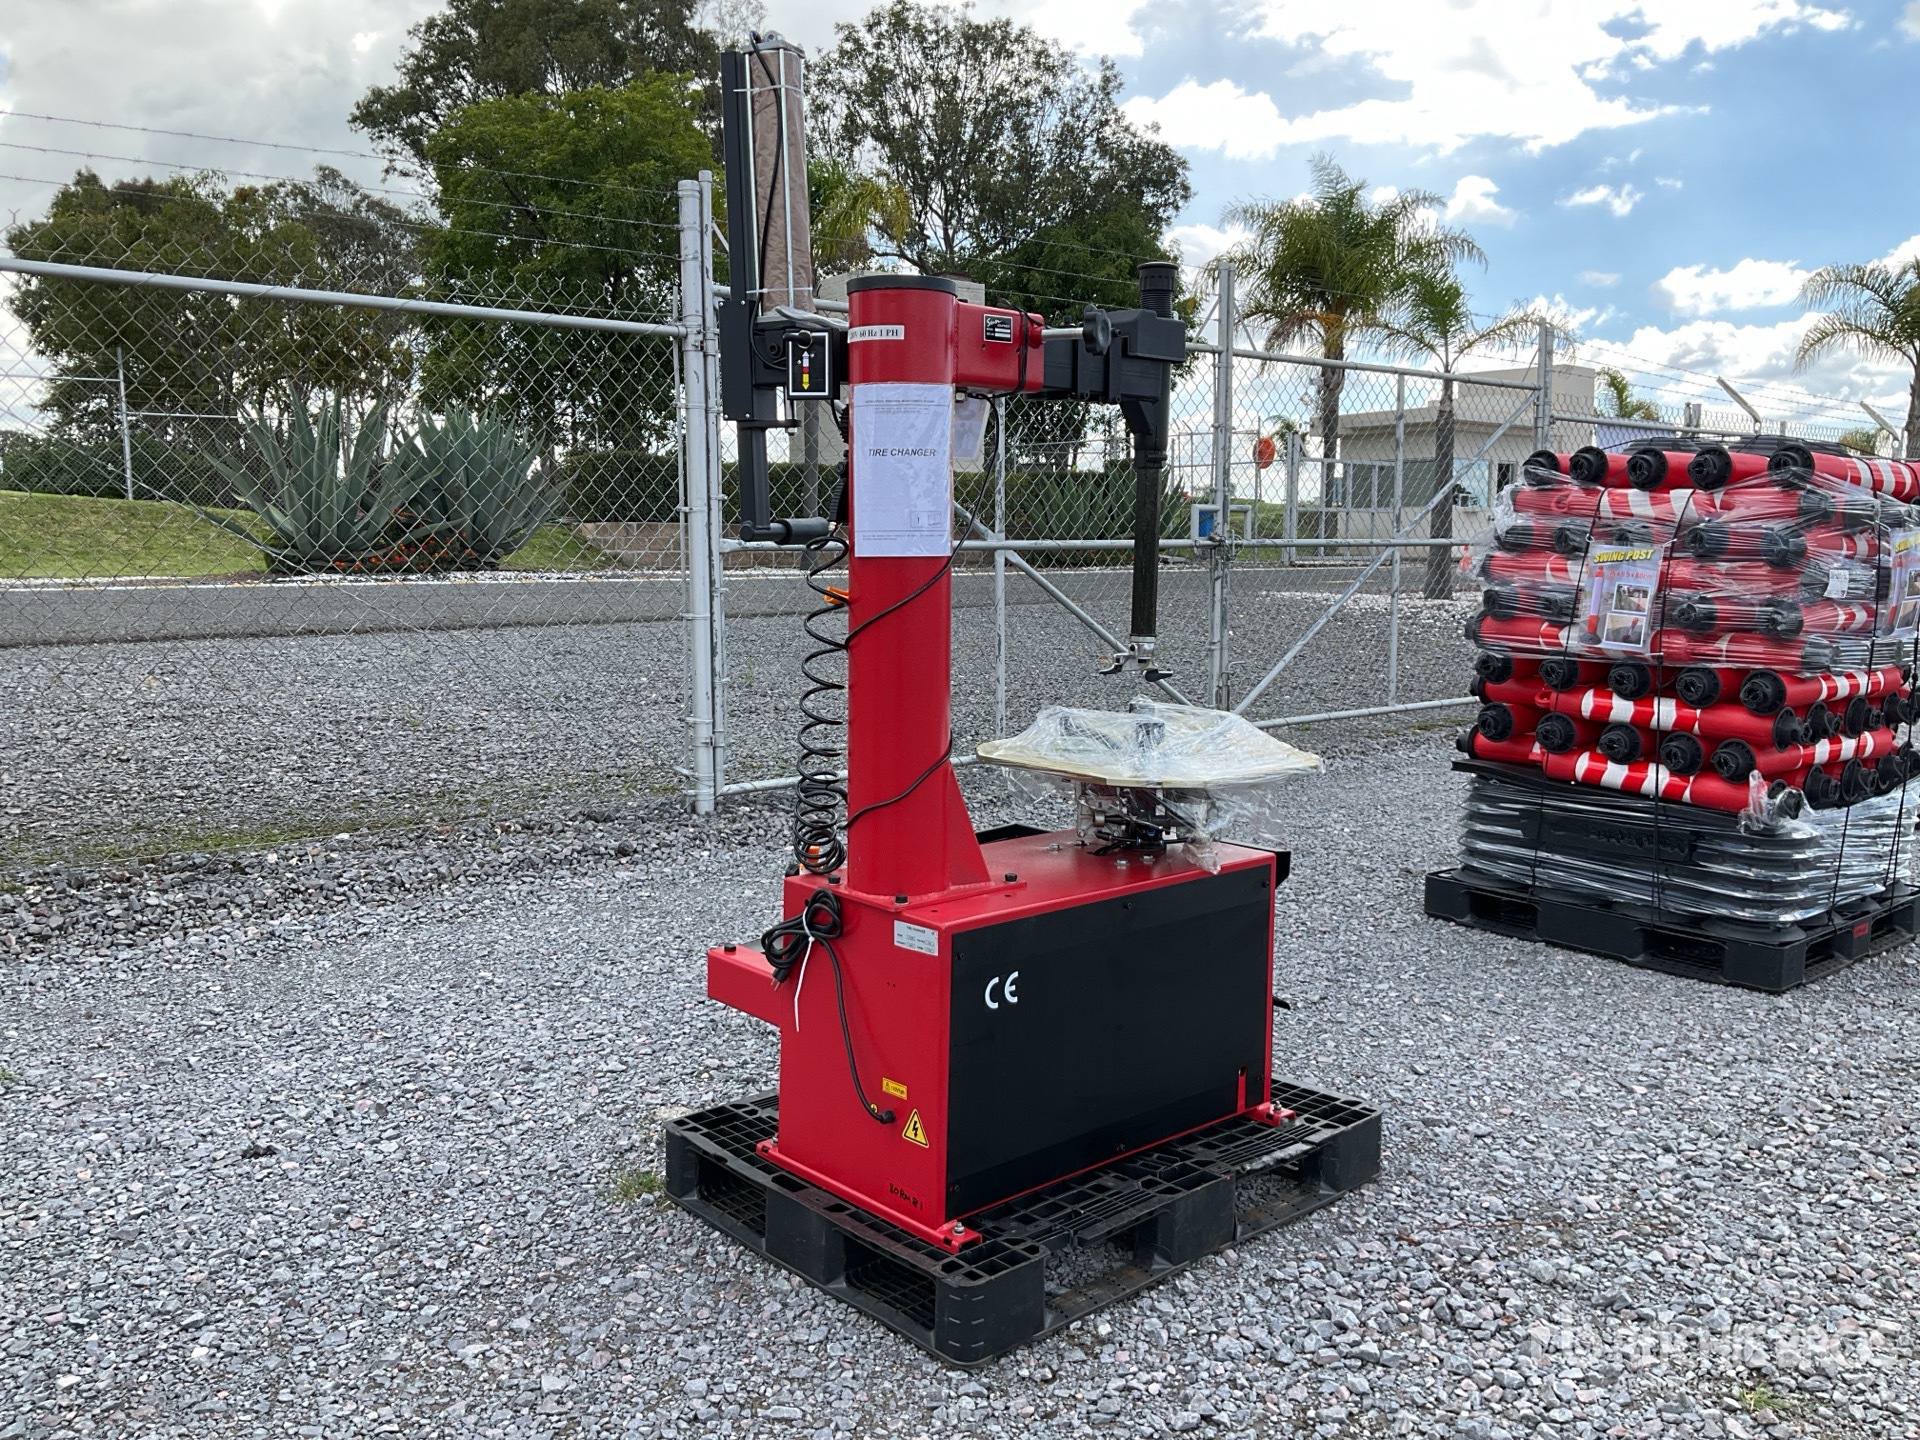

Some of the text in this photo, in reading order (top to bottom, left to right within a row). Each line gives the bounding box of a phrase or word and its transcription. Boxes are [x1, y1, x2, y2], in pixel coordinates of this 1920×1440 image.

[868, 329, 878, 337] Hz
[886, 329, 899, 337] PH
[868, 448, 937, 457] TIRE CHANGER
[1593, 549, 1654, 563] SWING POST
